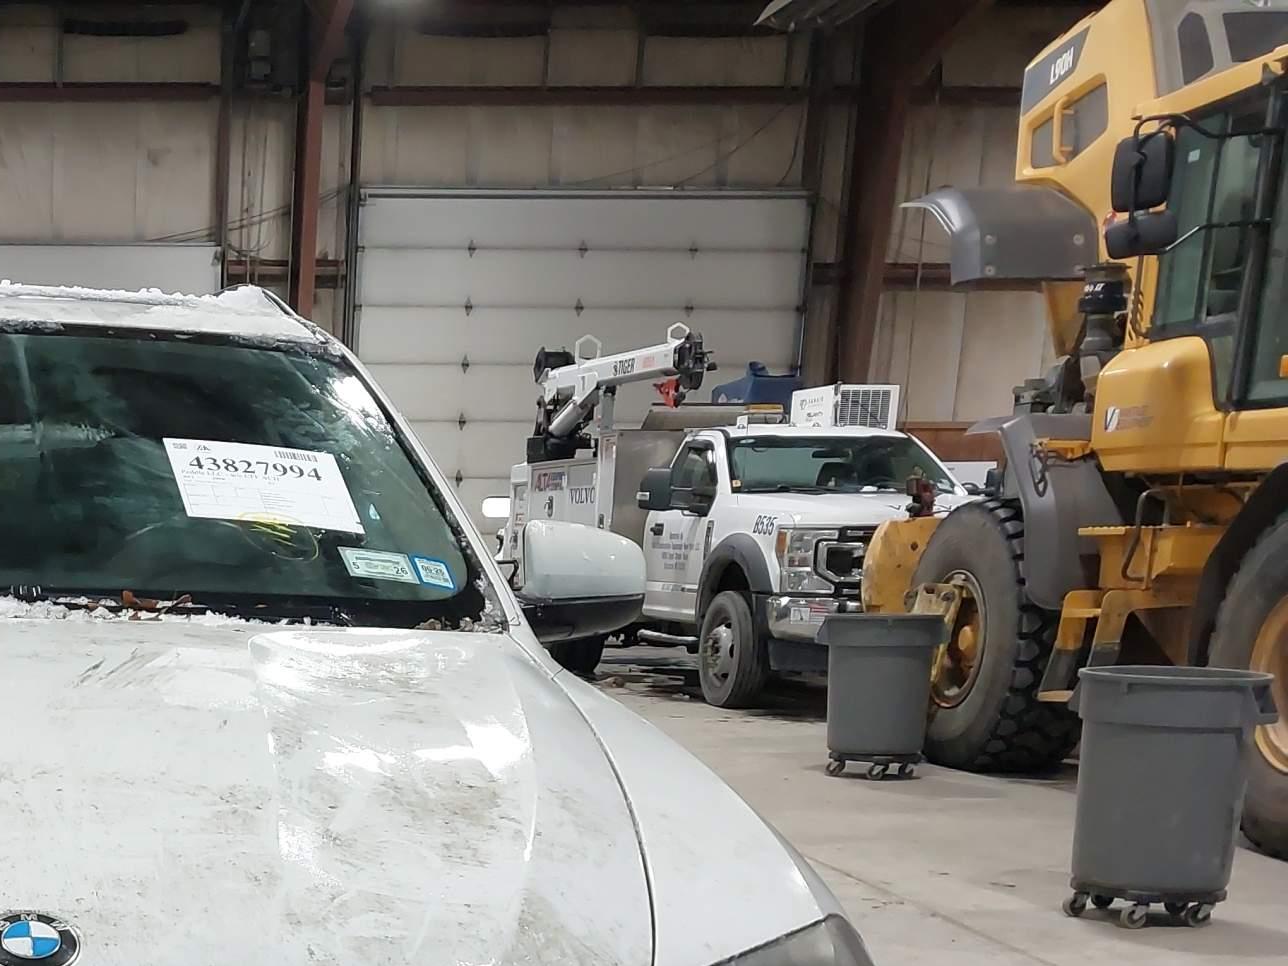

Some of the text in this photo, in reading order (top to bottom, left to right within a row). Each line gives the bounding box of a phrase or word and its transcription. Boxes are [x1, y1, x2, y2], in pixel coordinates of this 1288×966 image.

[618, 358, 636, 376] TIGER
[189, 456, 323, 482] 43827994
[393, 566, 409, 576] 26
